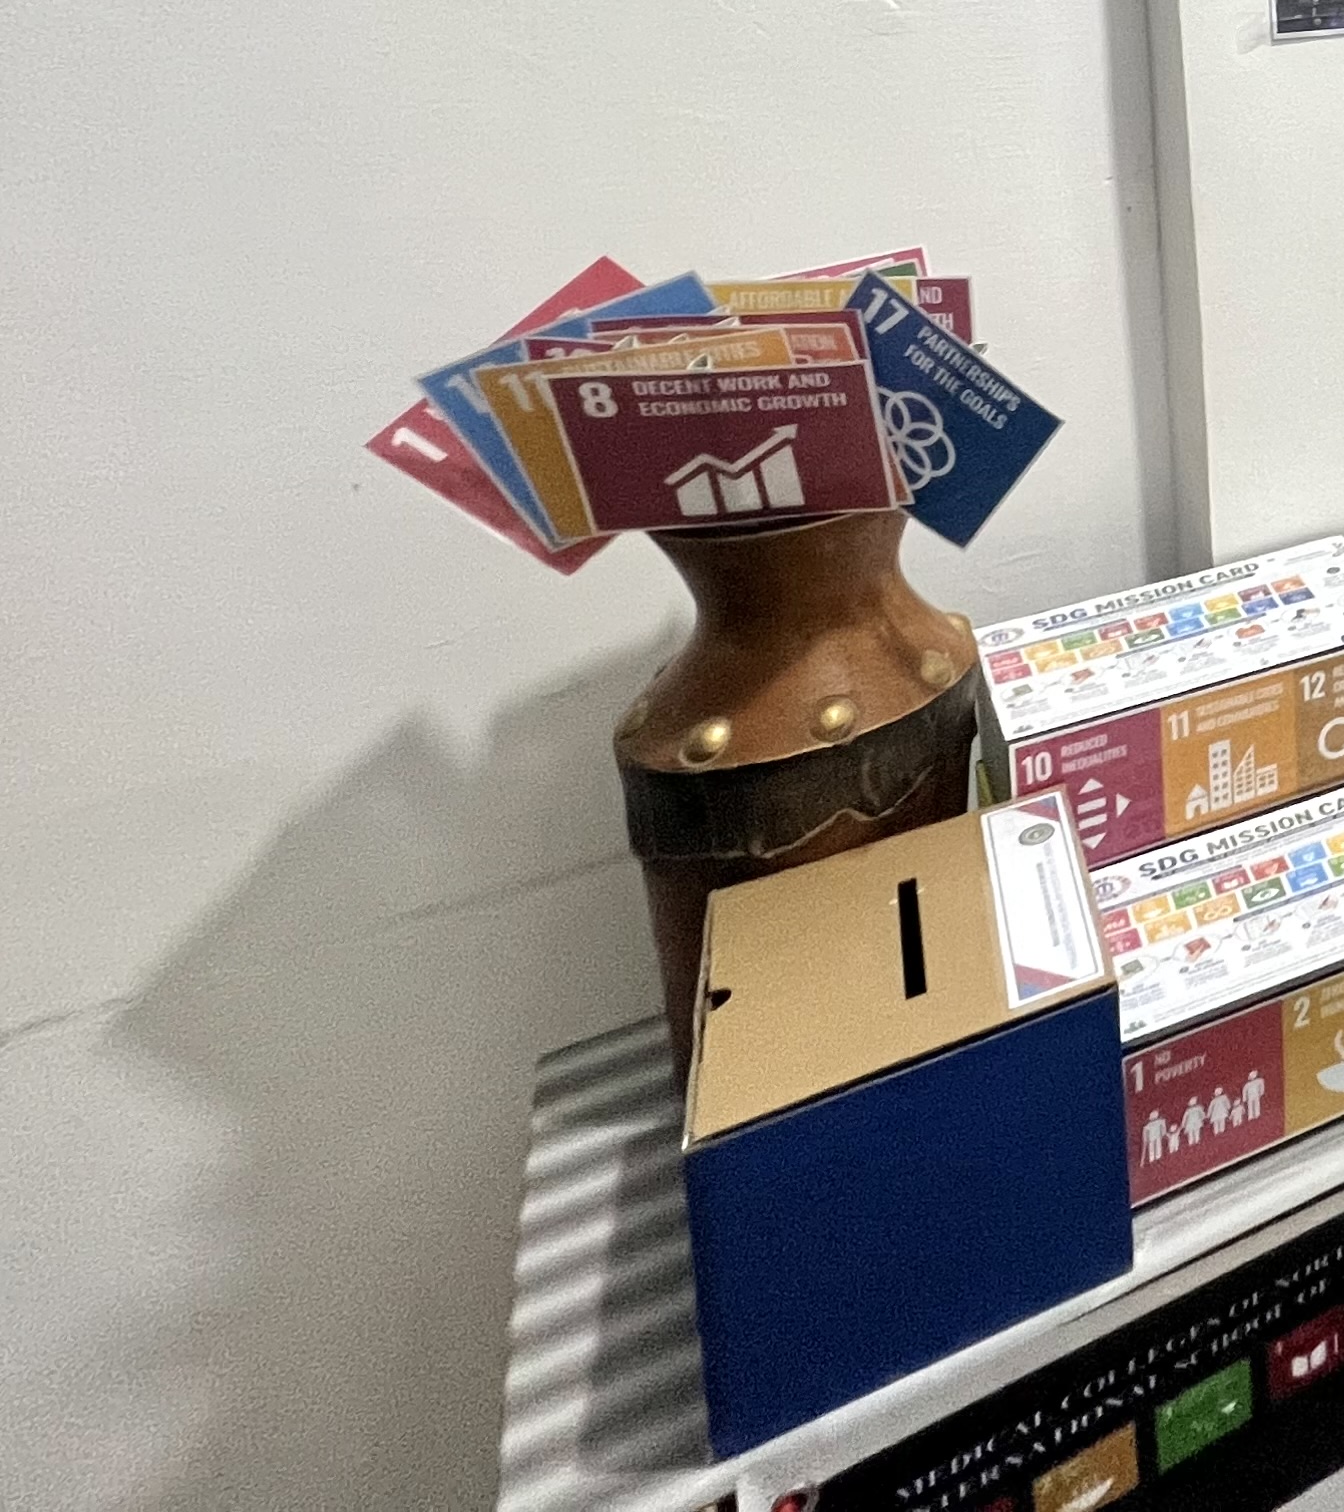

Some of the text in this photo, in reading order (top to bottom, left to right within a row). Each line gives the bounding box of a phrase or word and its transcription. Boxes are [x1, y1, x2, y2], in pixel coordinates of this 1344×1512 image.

[862, 287, 909, 336] 17
[631, 371, 831, 397] DECENT WORK AND
[914, 322, 1023, 414] PARTNERSHIPS
[578, 381, 619, 419] 8
[638, 391, 847, 417] ECONOMIC GROWTH
[901, 342, 1010, 432] FOR THE GOALS
[391, 426, 449, 463] 1
[1032, 562, 1259, 630] SDG MISSION CARD
[1299, 669, 1326, 704] 12
[1166, 707, 1190, 743] 11
[1060, 732, 1108, 760] REDUCED
[1060, 742, 1127, 776] INEQUALITIES
[1021, 748, 1052, 788] 10
[1137, 848, 1201, 879] SDG
[1206, 809, 1315, 857] MISSION
[1292, 992, 1311, 1030] 2
[1154, 1048, 1171, 1067] NO
[1154, 1053, 1205, 1085] POVERTY
[1129, 1060, 1144, 1095] 1
